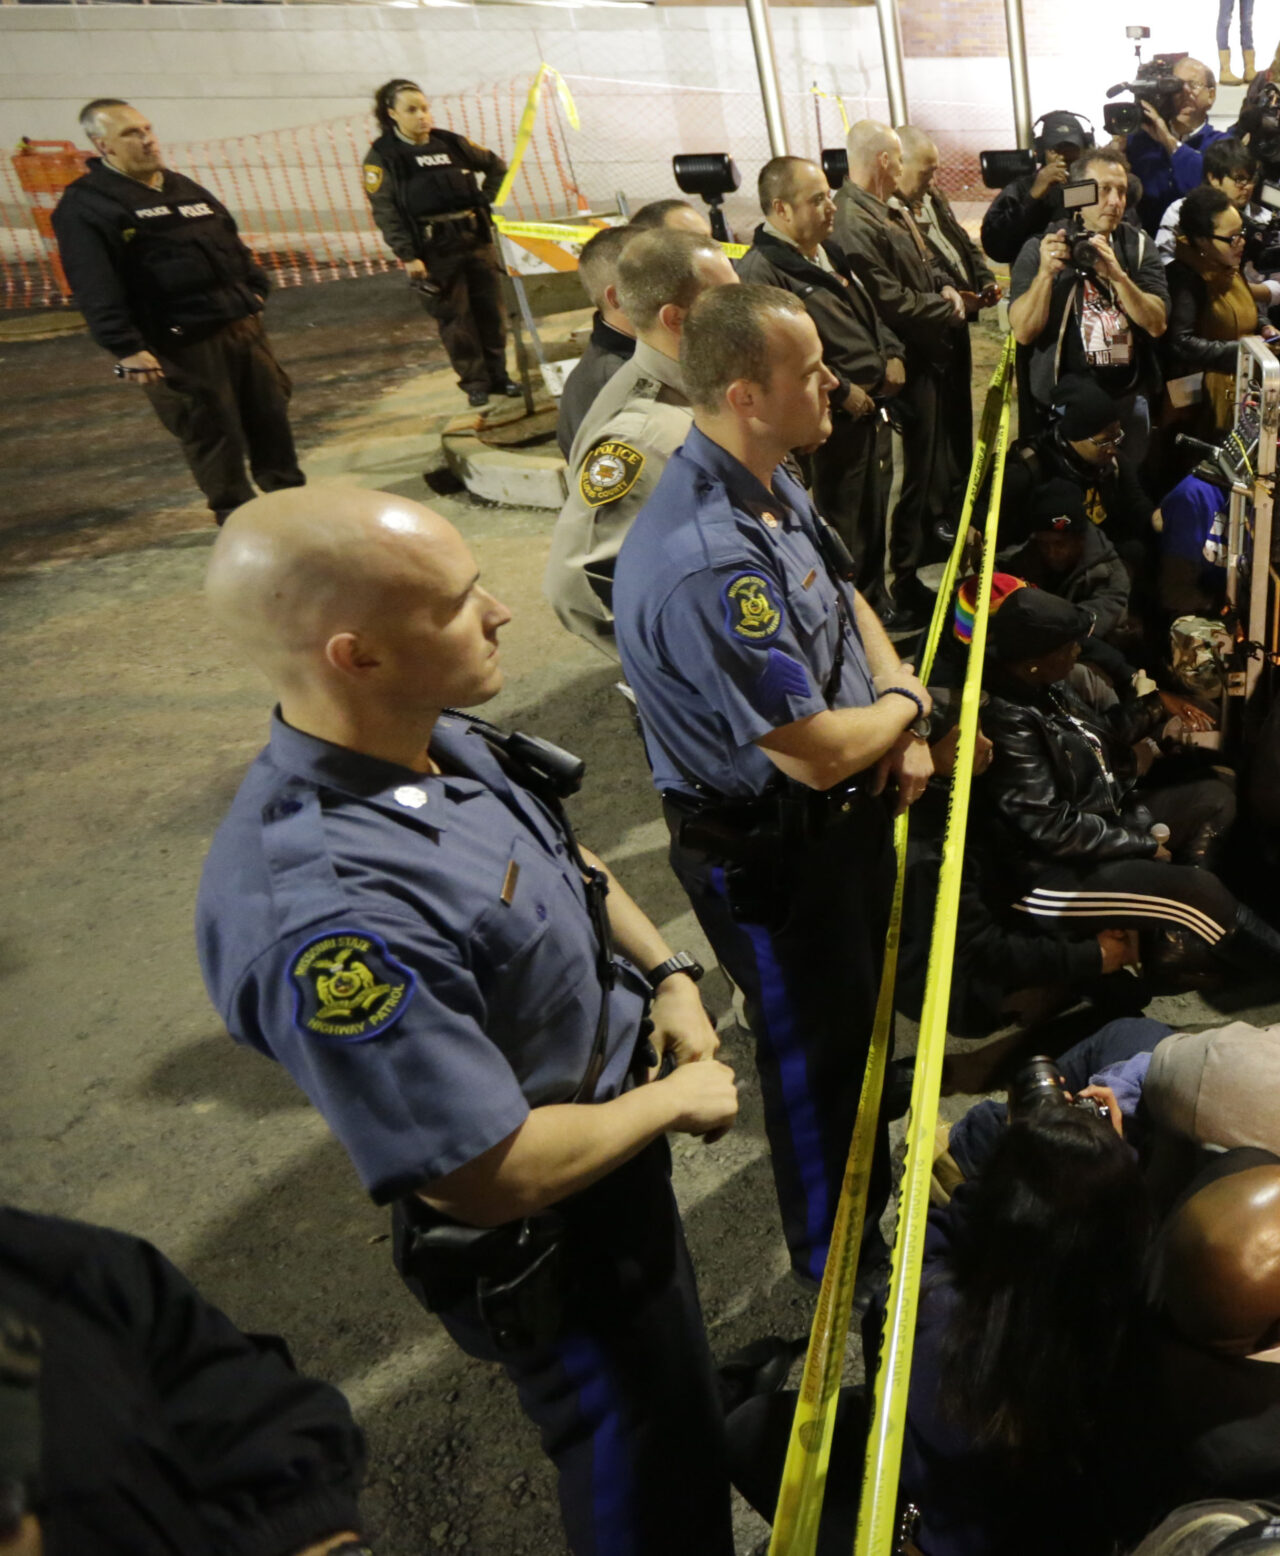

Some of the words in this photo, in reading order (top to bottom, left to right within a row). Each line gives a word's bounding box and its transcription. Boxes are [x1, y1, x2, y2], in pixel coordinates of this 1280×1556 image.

[415, 153, 452, 168] POLICE
[593, 444, 641, 465] POLICE
[307, 1018, 365, 1036] HIGHWAY
[369, 983, 405, 1026] PATROL
